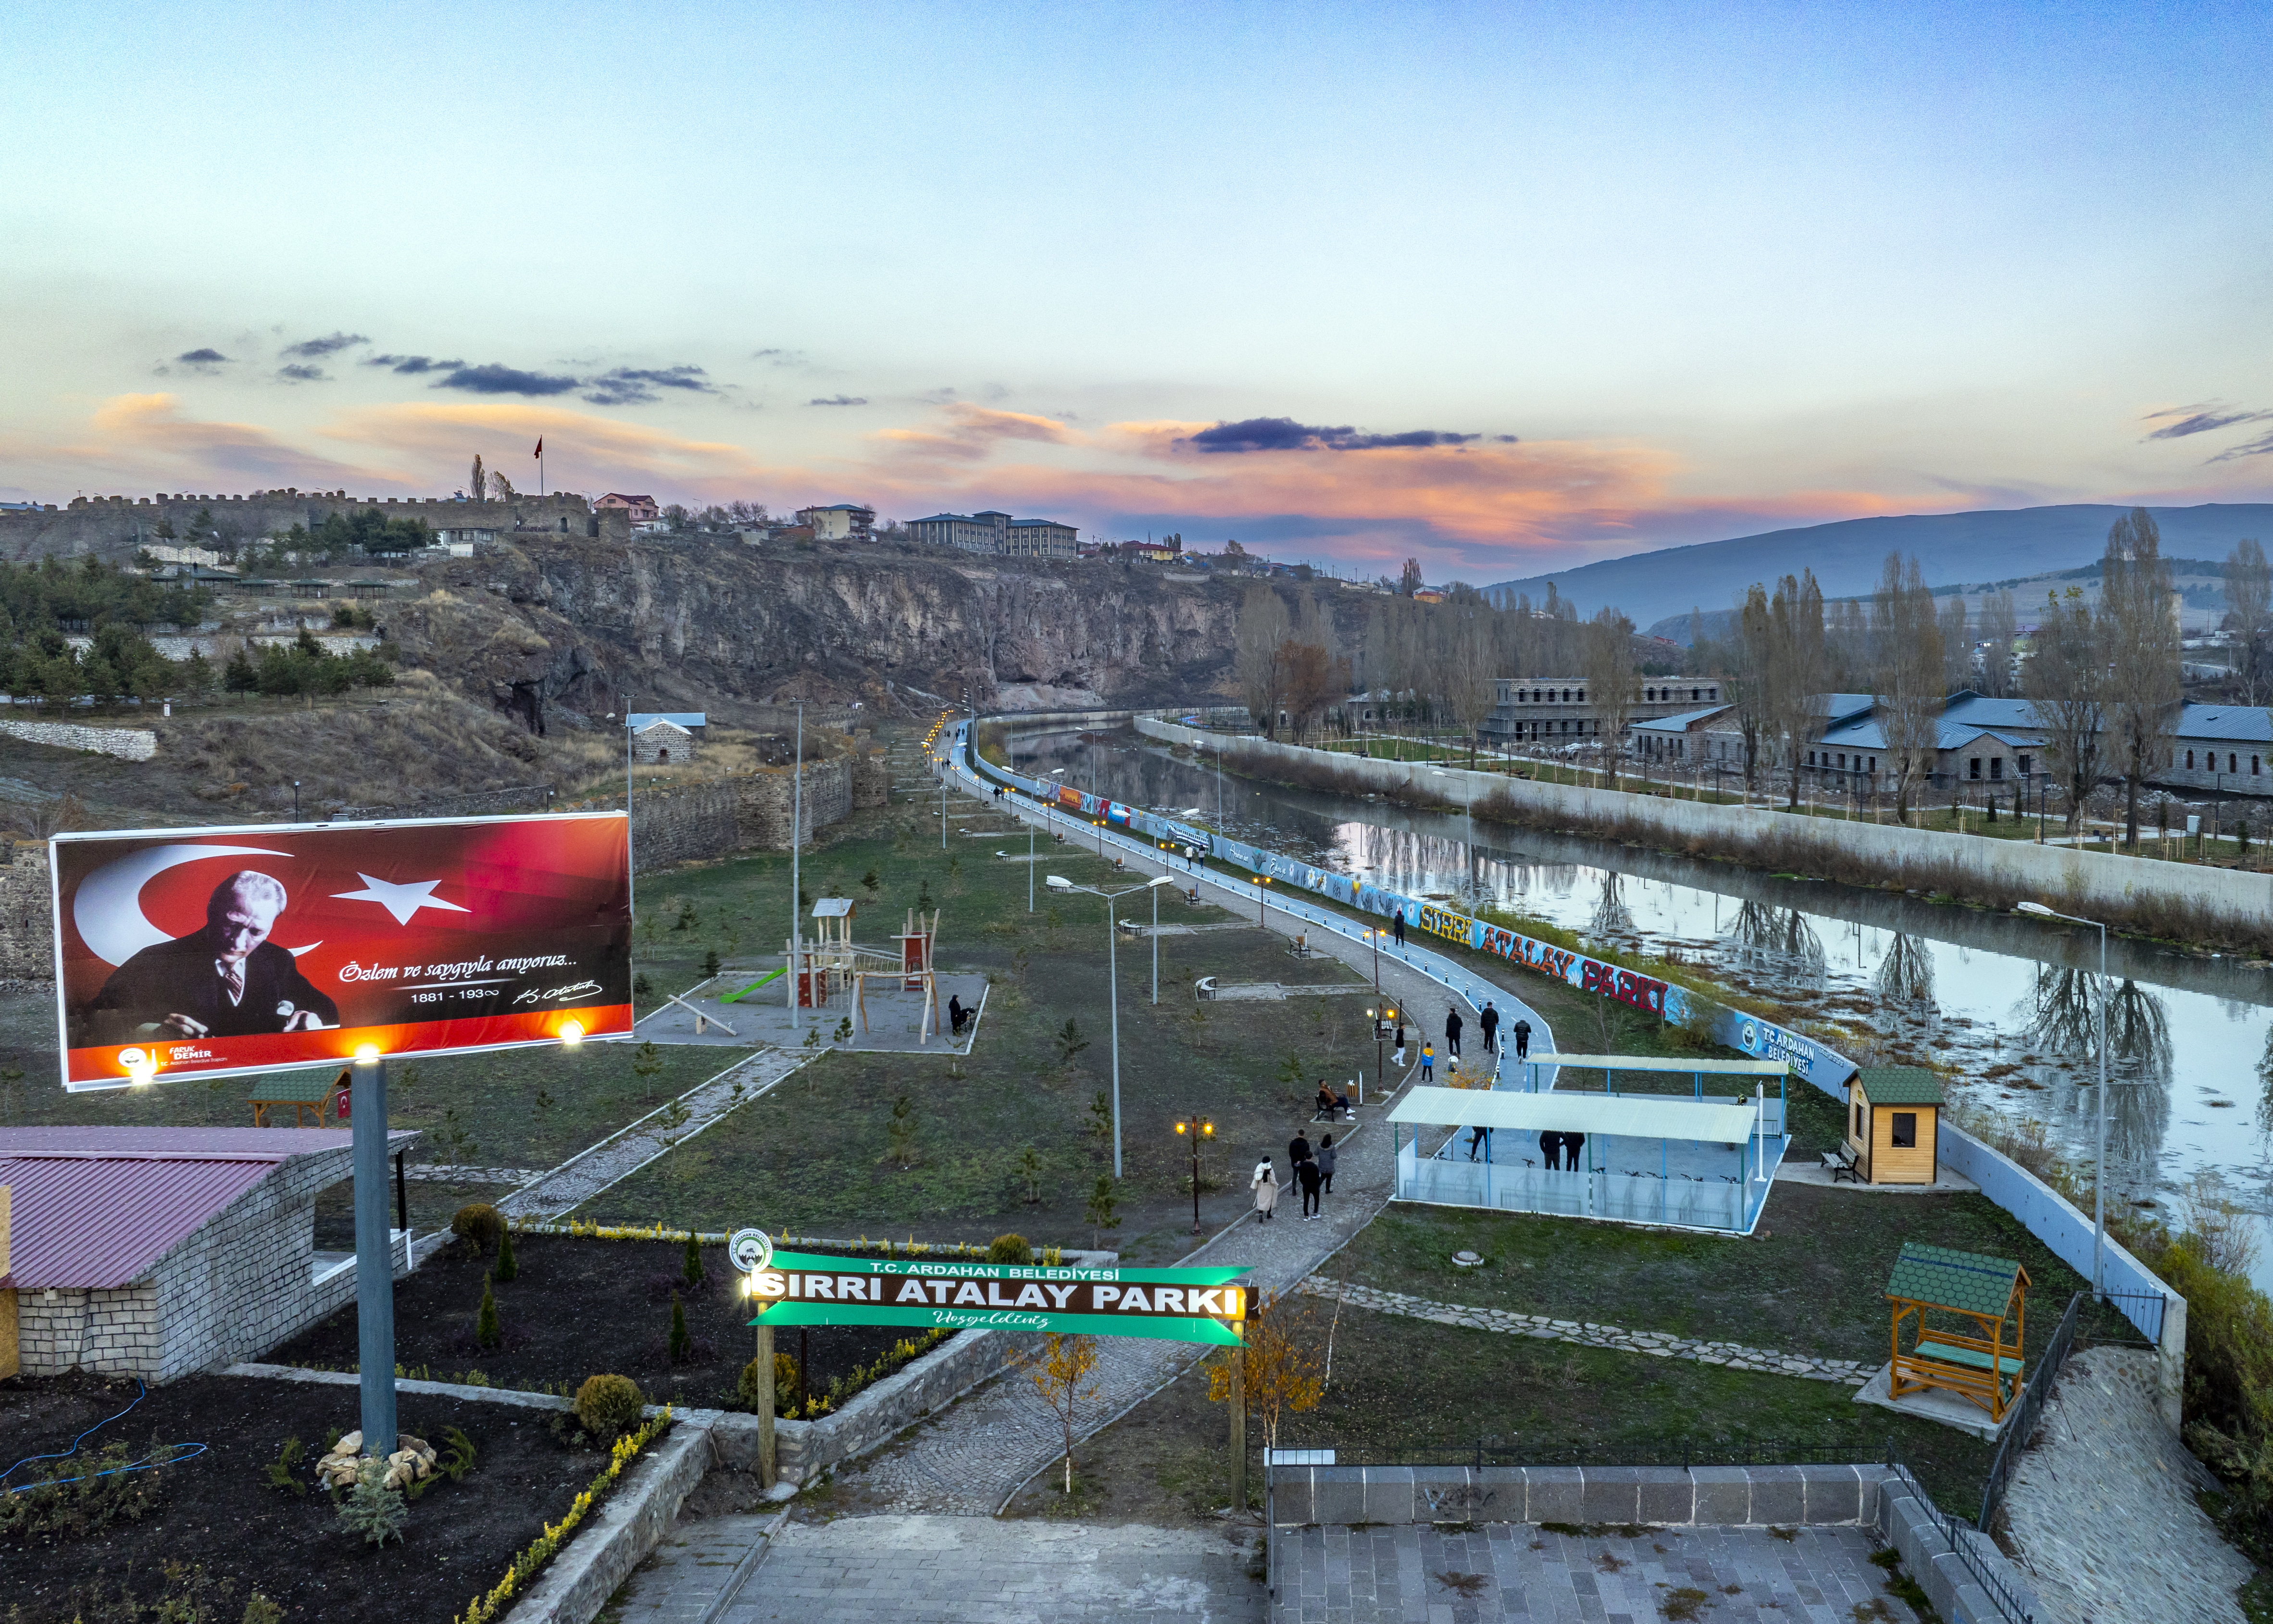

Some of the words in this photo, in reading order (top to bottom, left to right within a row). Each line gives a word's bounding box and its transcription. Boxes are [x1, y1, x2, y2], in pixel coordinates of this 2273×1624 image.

[339, 961, 397, 982] Özlem
[403, 966, 420, 978] ve
[425, 955, 491, 980] saygıyla
[1421, 905, 1472, 944] SIRRI
[1481, 927, 1575, 979] ATALAY
[1583, 961, 1669, 1016] PARKI
[411, 992, 443, 1003] 1881
[169, 1046, 195, 1054] FARUK
[174, 1049, 212, 1060] DEMİR
[1768, 1044, 1809, 1076] BELEDİYESİ
[735, 1233, 751, 1246] ARDAHAN
[870, 1262, 902, 1273] T.C.
[907, 1264, 999, 1277] ARDAHAN
[1009, 1268, 1119, 1280] BELEDİYESİ
[759, 1273, 881, 1300] SIRRI
[895, 1279, 1078, 1308] ATALAY
[1093, 1286, 1237, 1314] PARKI
[933, 1311, 1053, 1329] Hoşgeldiniz
